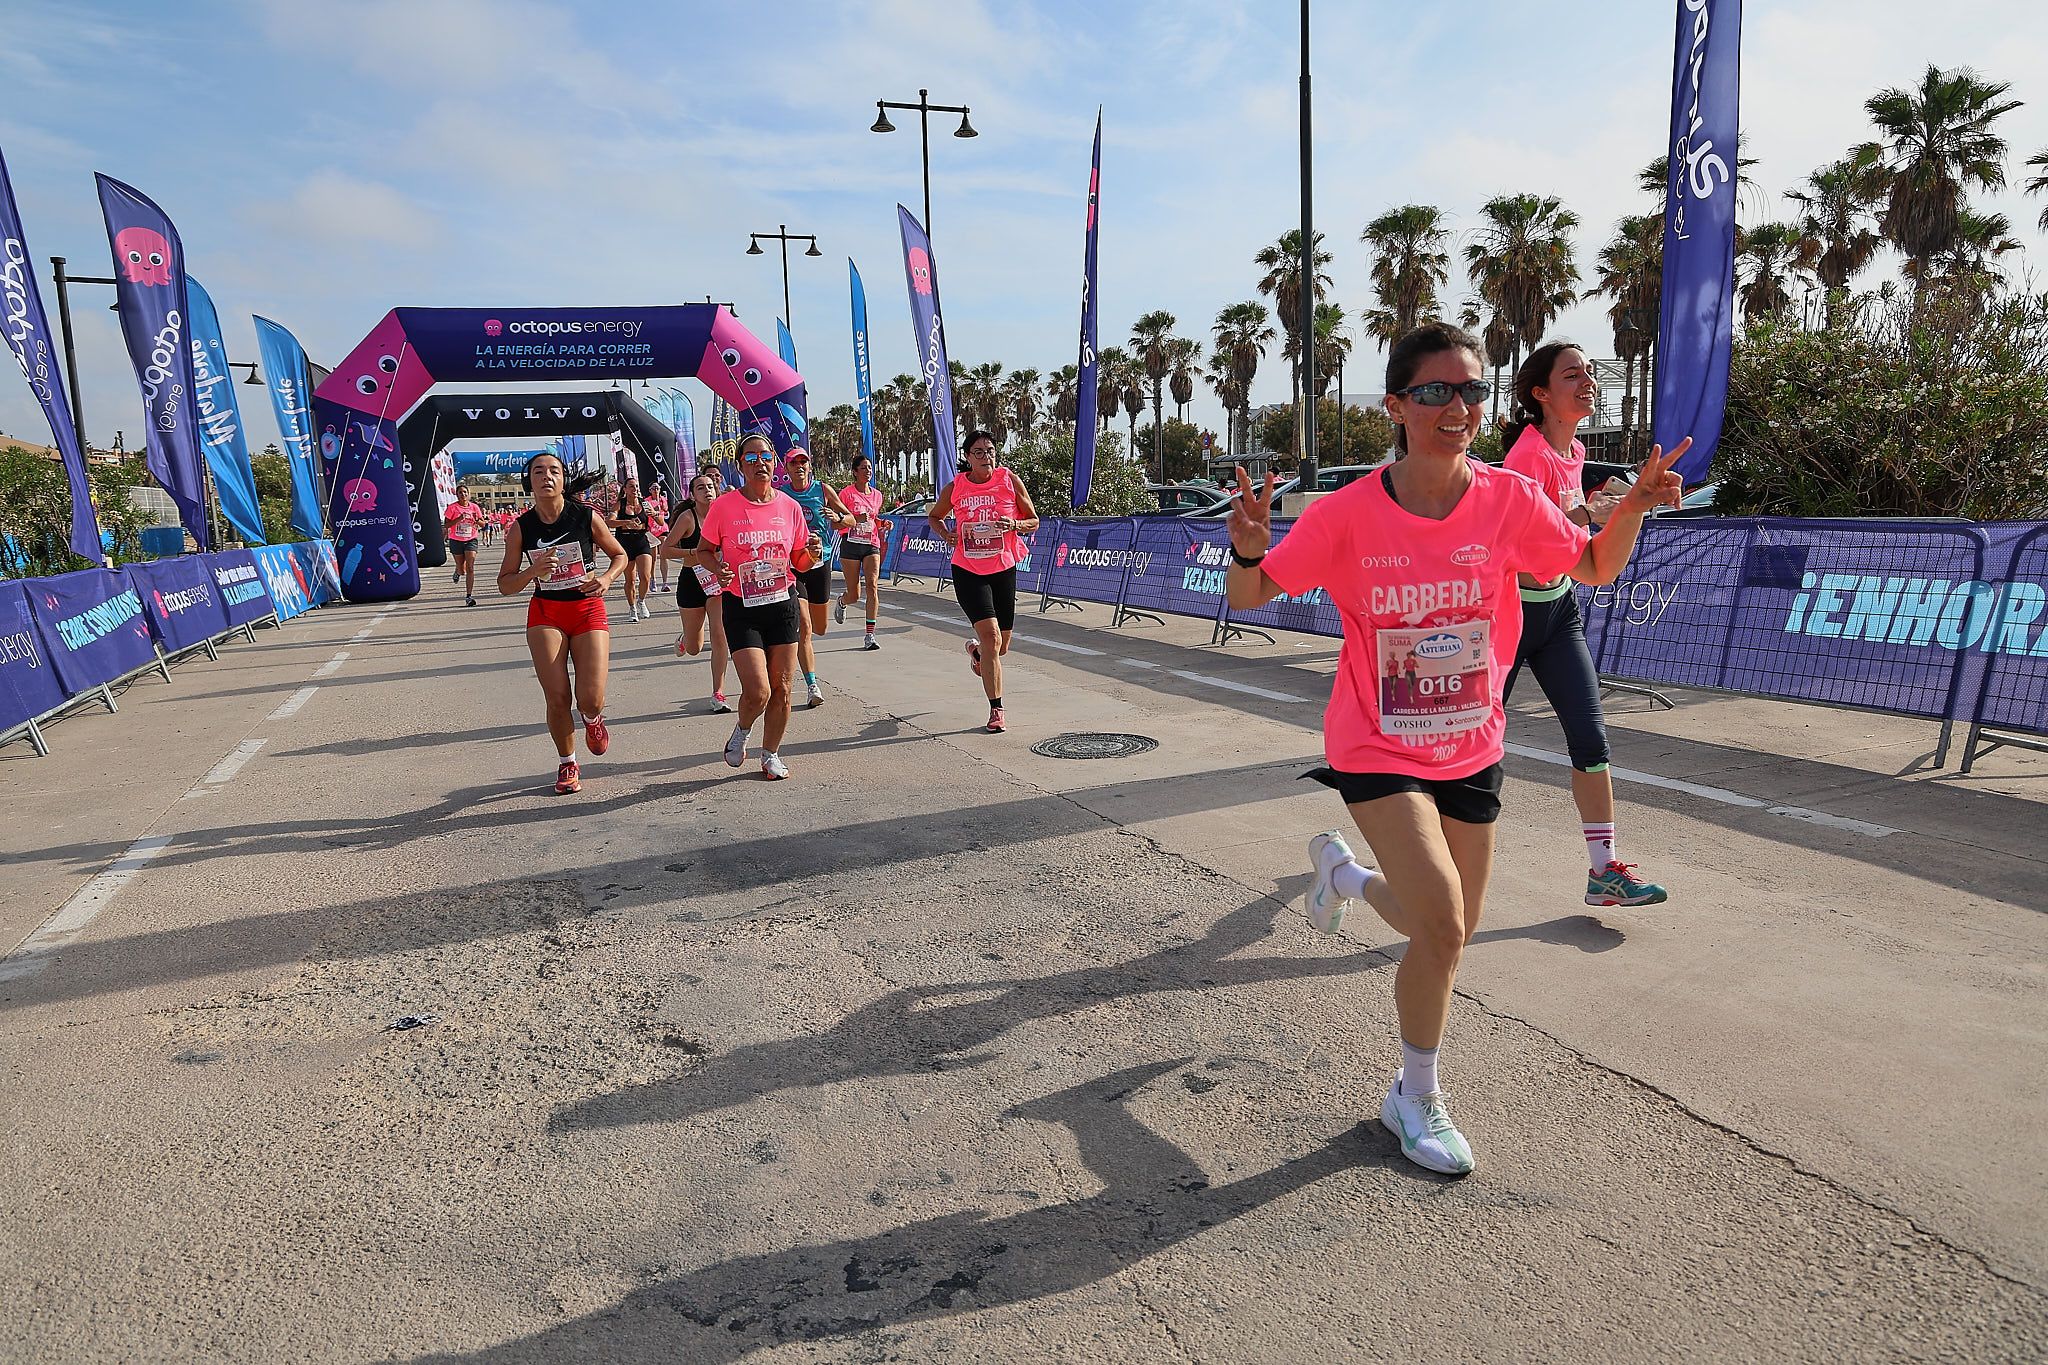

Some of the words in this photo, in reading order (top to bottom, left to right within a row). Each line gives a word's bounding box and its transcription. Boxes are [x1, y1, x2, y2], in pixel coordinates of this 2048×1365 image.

[509, 320, 582, 337] octopus
[583, 320, 643, 338] energy
[475, 345, 494, 355] LA
[497, 343, 556, 355] ENERGÍA
[559, 345, 595, 355] PARA
[598, 344, 651, 354] CORRER
[475, 359, 486, 368] A
[489, 359, 506, 368] LA
[509, 359, 586, 368] VELOCIDAD
[589, 358, 607, 367] DE
[609, 358, 626, 367] LA
[629, 357, 655, 366] LUZ
[462, 406, 597, 420] VOLVO
[485, 453, 528, 471] Marlene
[367, 516, 398, 526] energy
[1069, 546, 1111, 571] octopus
[1110, 550, 1152, 578] energy
[1361, 555, 1410, 568] OYSHO
[757, 579, 776, 588] 016
[1573, 581, 1680, 627] nergy
[1418, 643, 1461, 655] ASTURIANA
[1419, 674, 1463, 695] 016
[1392, 707, 1420, 715] CARRERA
[1420, 707, 1428, 715] DE
[1429, 706, 1438, 714] LA
[1438, 705, 1458, 714] MUJER
[1393, 720, 1432, 729] OYSHO
[1454, 714, 1483, 726] Santander
